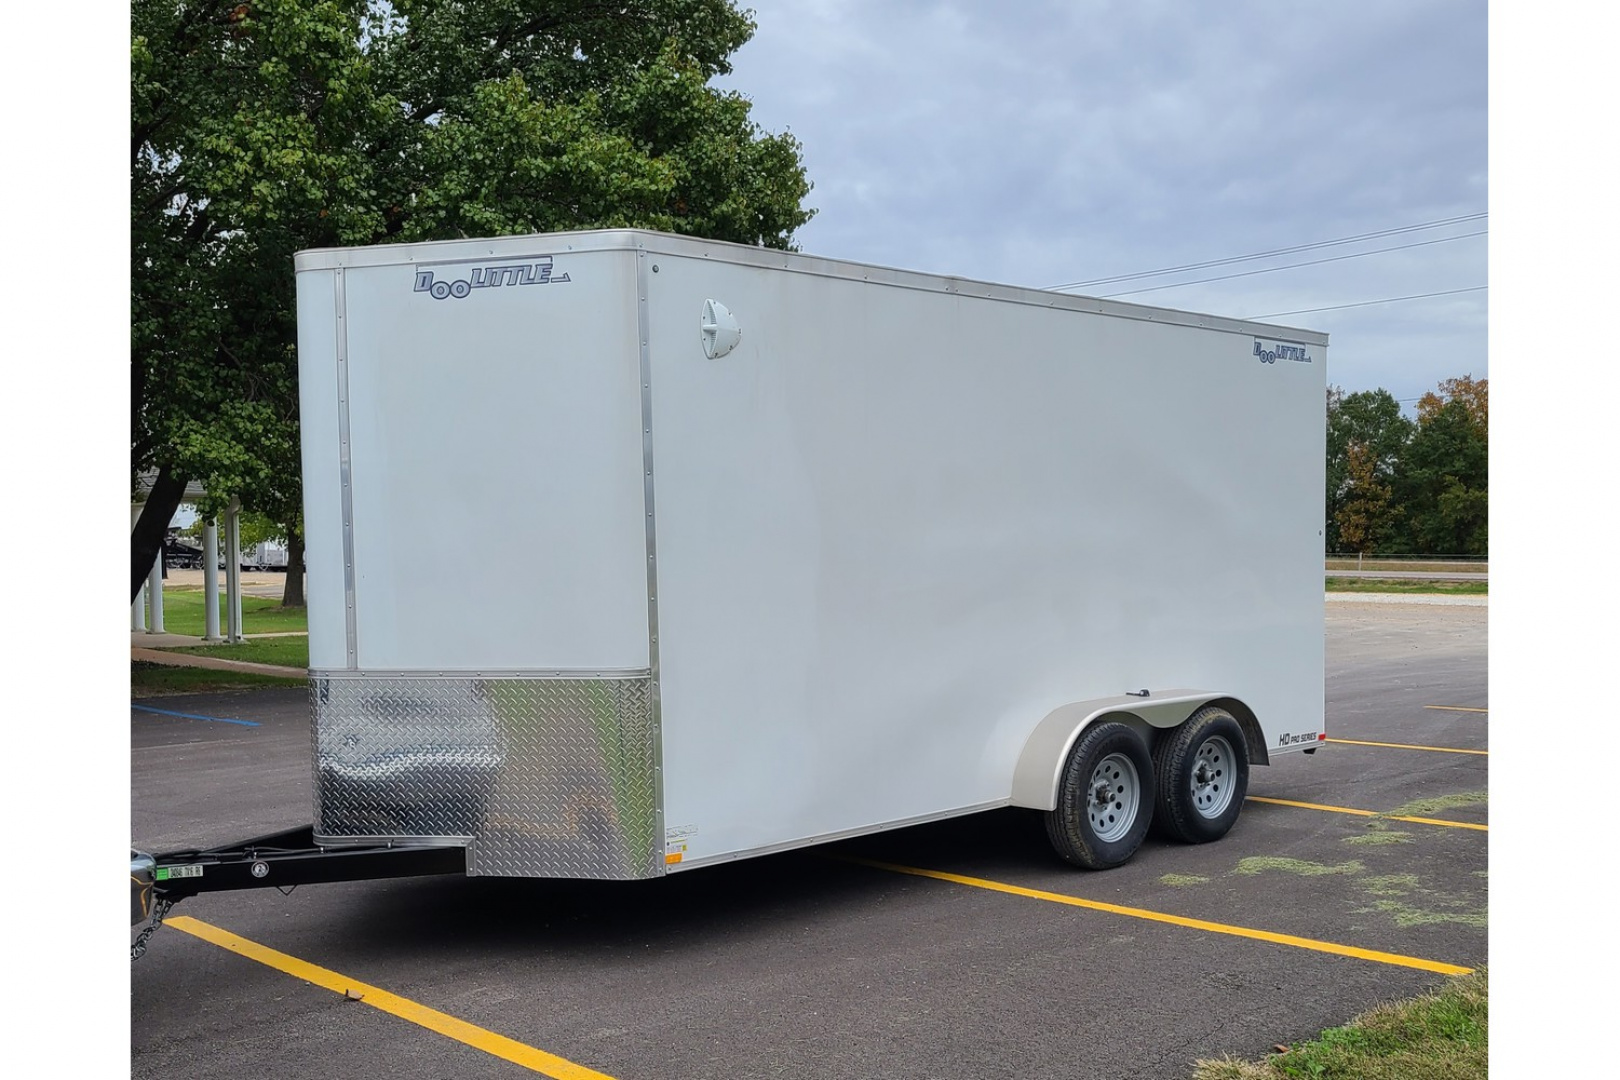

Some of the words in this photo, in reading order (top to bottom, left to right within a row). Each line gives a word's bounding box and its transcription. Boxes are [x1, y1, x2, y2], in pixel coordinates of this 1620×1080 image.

[413, 263, 554, 300] DOOLITTLE
[1253, 341, 1306, 364] DOOLITTLE
[1278, 733, 1290, 747] HD
[1290, 735, 1300, 744] PRO
[1300, 731, 1317, 743] SERIES
